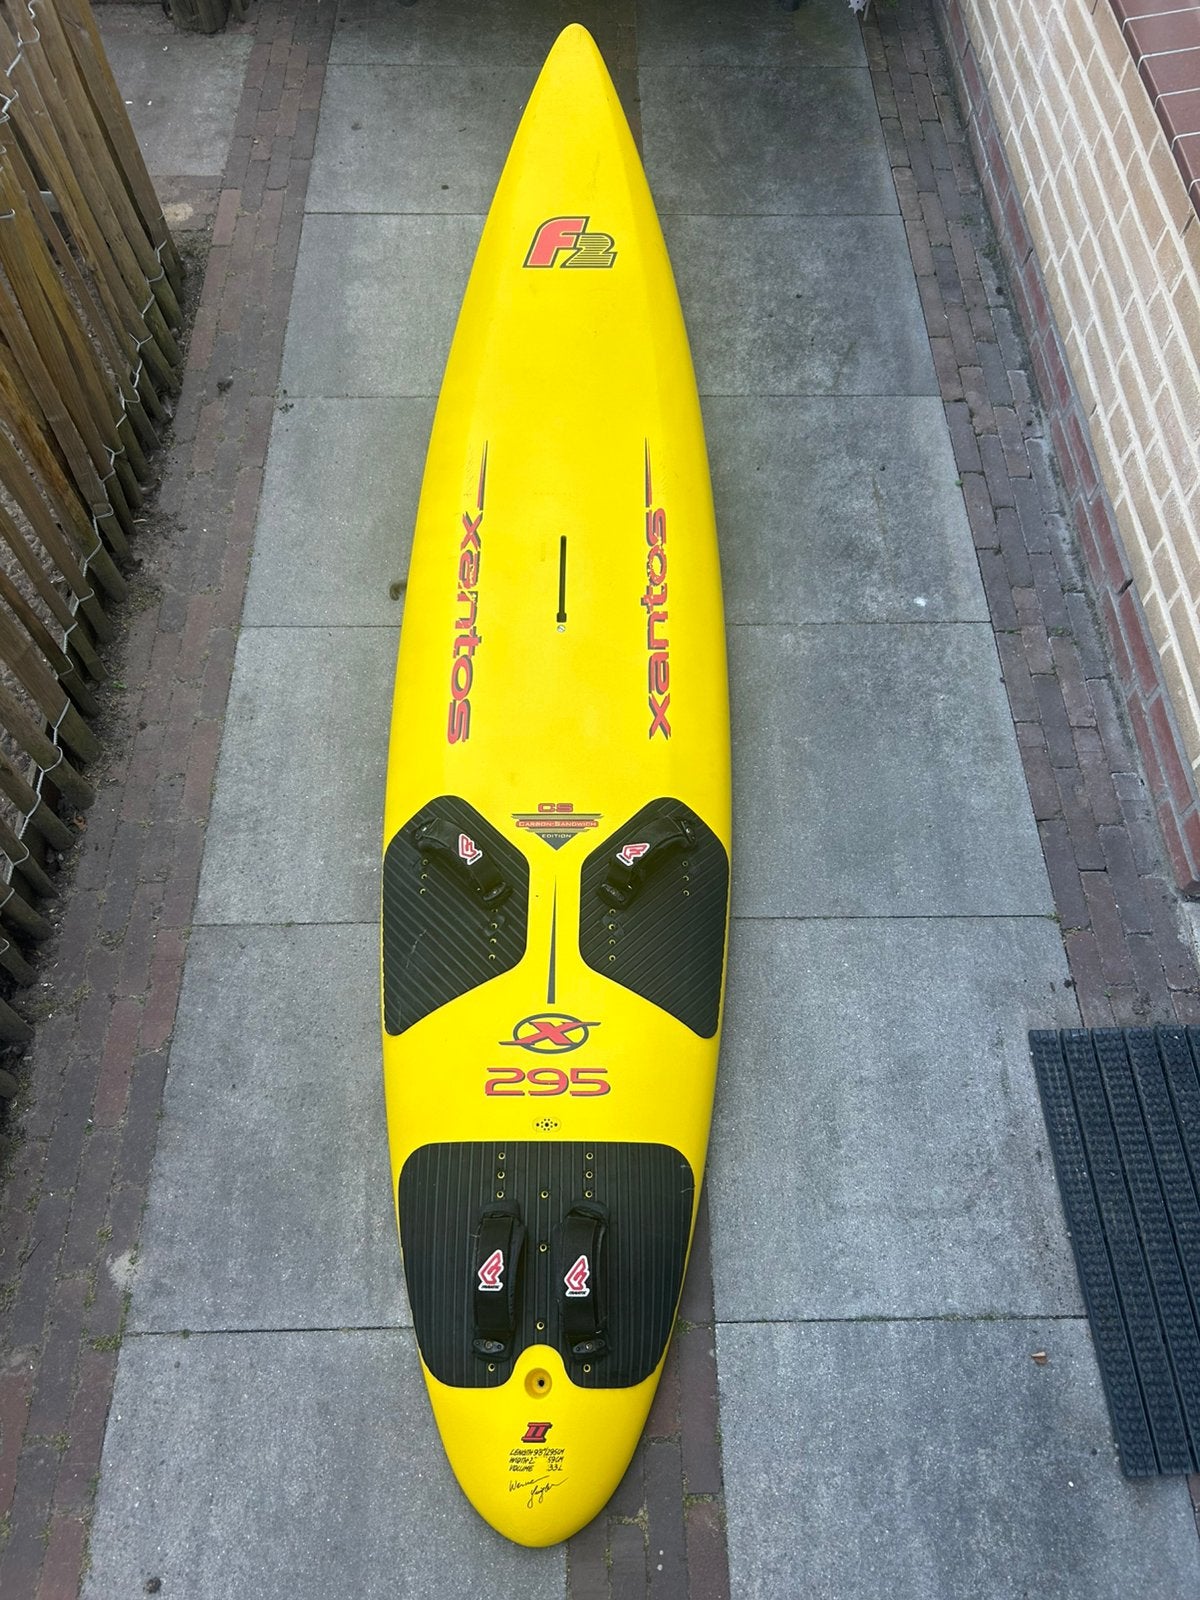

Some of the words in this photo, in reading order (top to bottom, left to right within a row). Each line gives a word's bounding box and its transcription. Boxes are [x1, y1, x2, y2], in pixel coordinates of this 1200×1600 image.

[522, 216, 618, 268] F2
[537, 803, 574, 813] CS
[485, 1068, 611, 1097] 295
